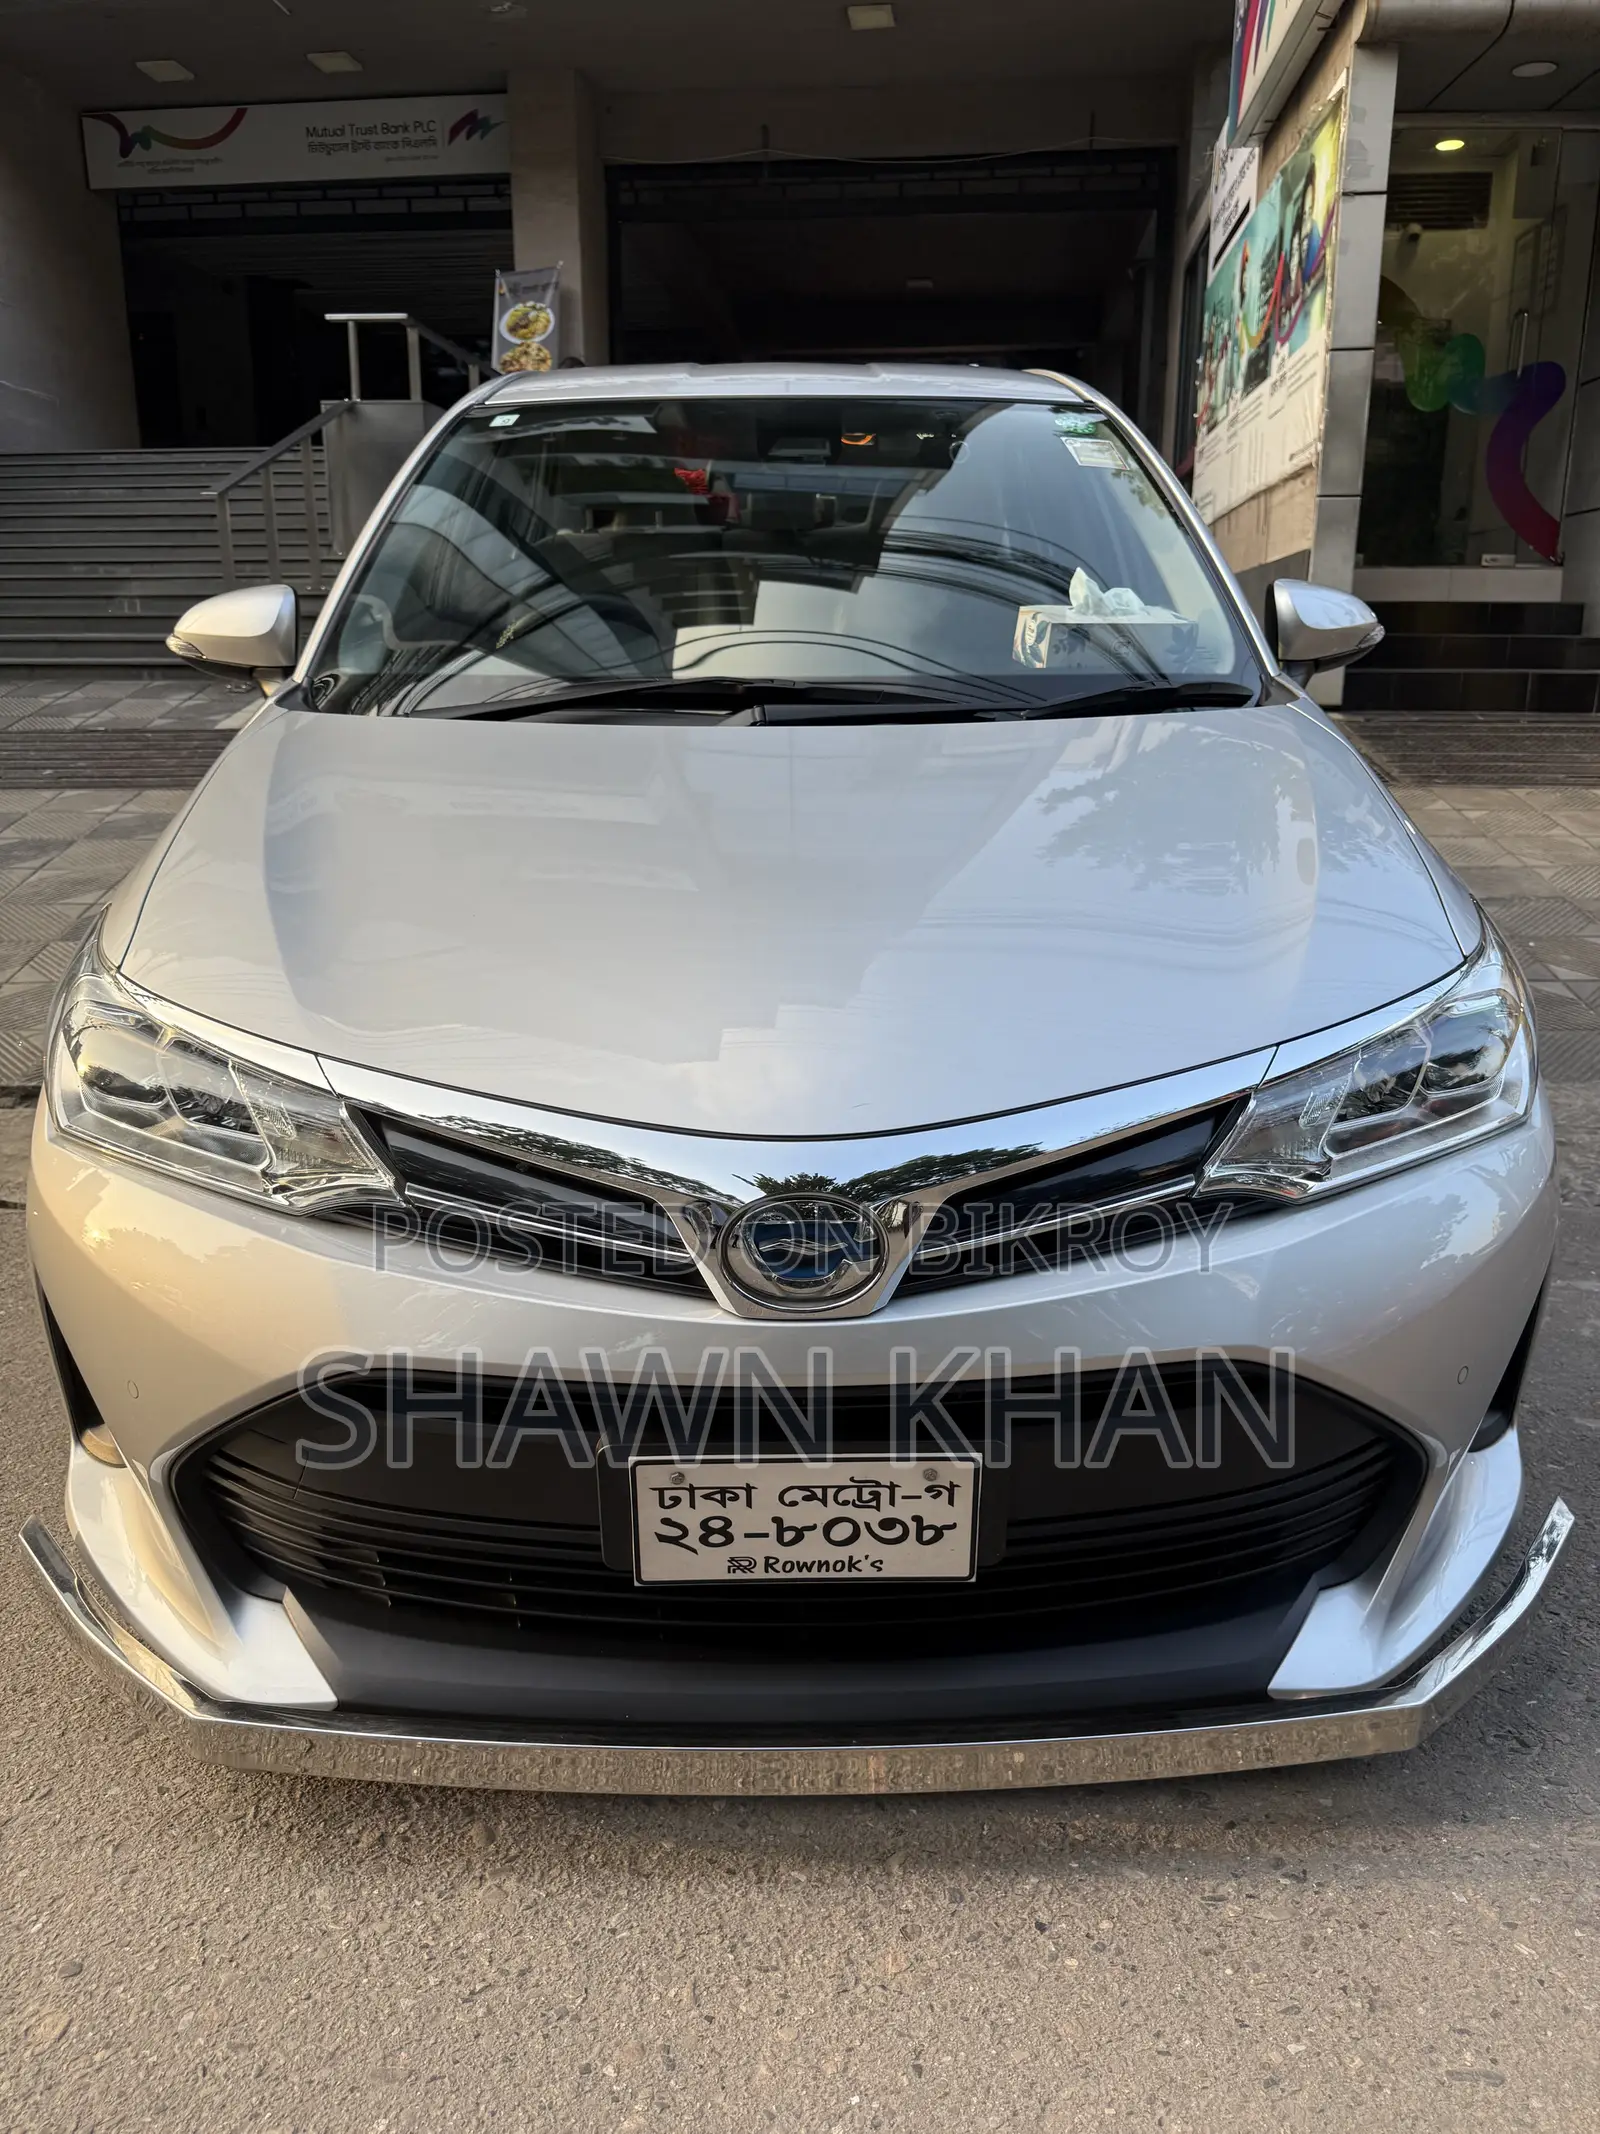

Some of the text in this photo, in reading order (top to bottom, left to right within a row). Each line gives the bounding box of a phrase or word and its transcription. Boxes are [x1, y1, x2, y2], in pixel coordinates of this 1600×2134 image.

[305, 120, 437, 138] Mutual Trust Bank PLC
[649, 1476, 962, 1512] ঢাকা মেট্রো-গ
[653, 1514, 958, 1556] ২৪-৮০৩৮
[763, 1553, 884, 1575] Rownok's
